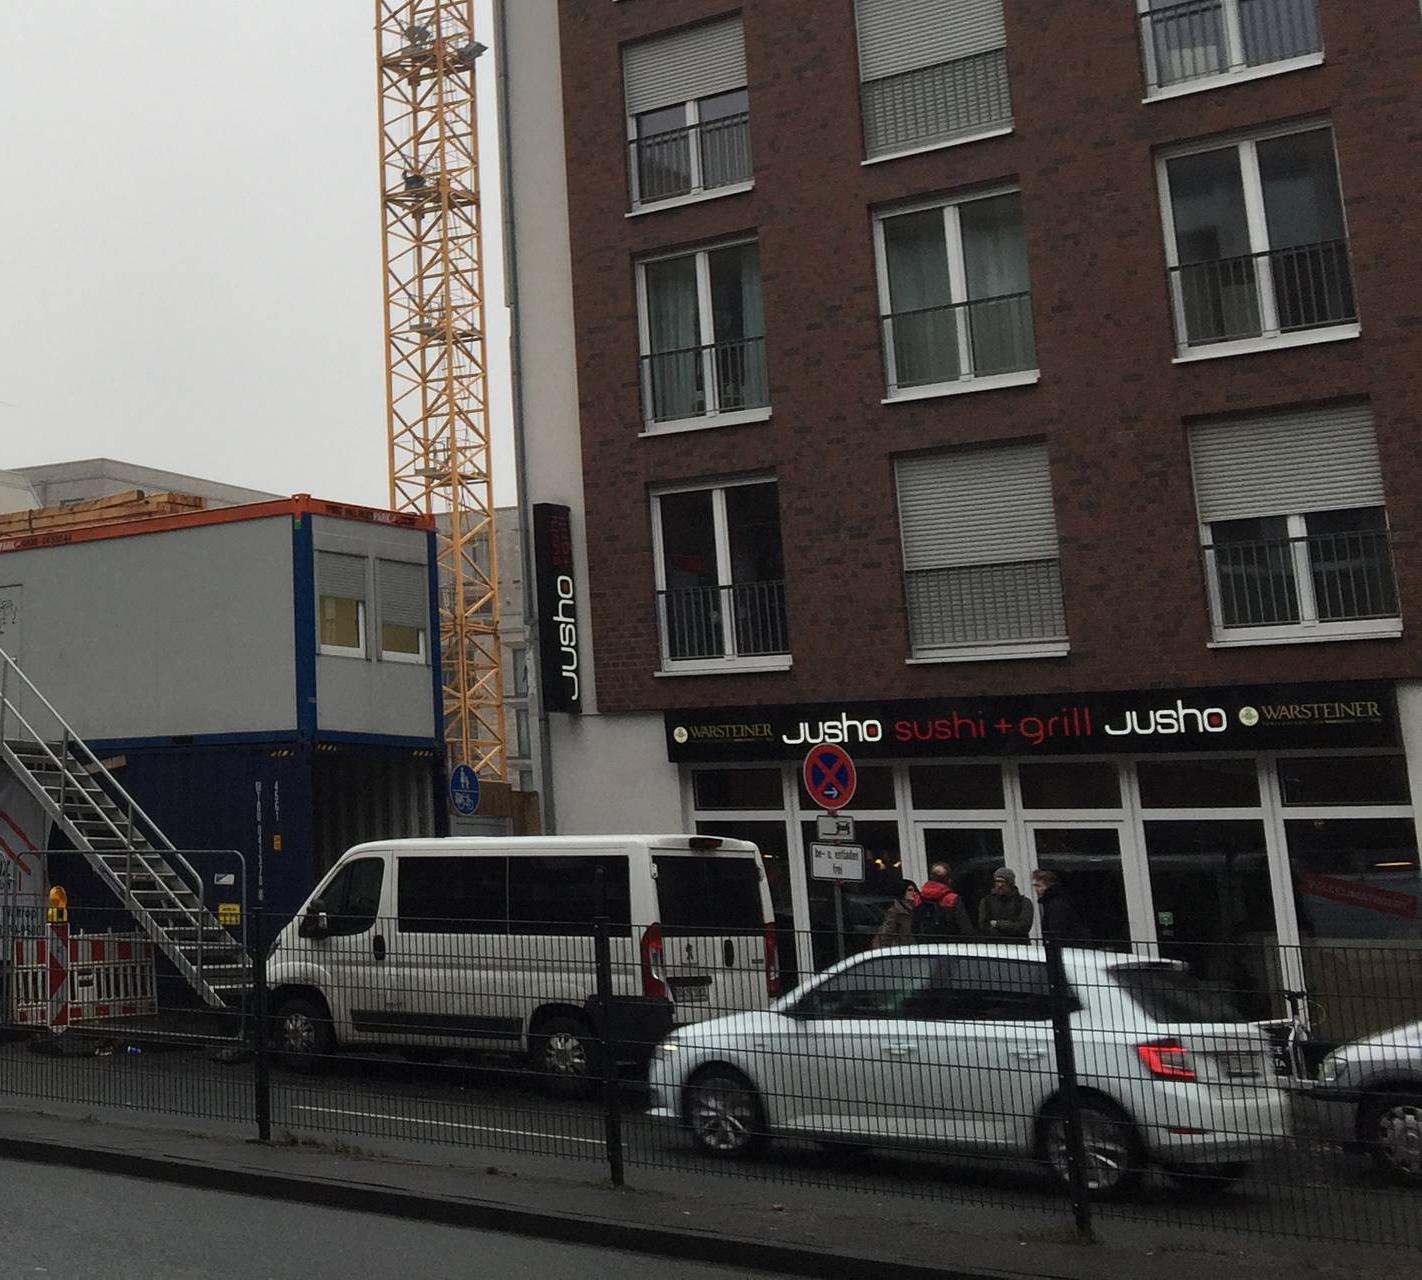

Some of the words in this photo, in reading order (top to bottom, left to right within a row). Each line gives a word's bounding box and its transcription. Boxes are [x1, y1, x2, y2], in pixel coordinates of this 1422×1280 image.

[1261, 701, 1381, 719] WARSTEINER
[689, 722, 773, 738] WARSTEINER
[894, 709, 986, 741] sushi
[1018, 706, 1091, 744] grill
